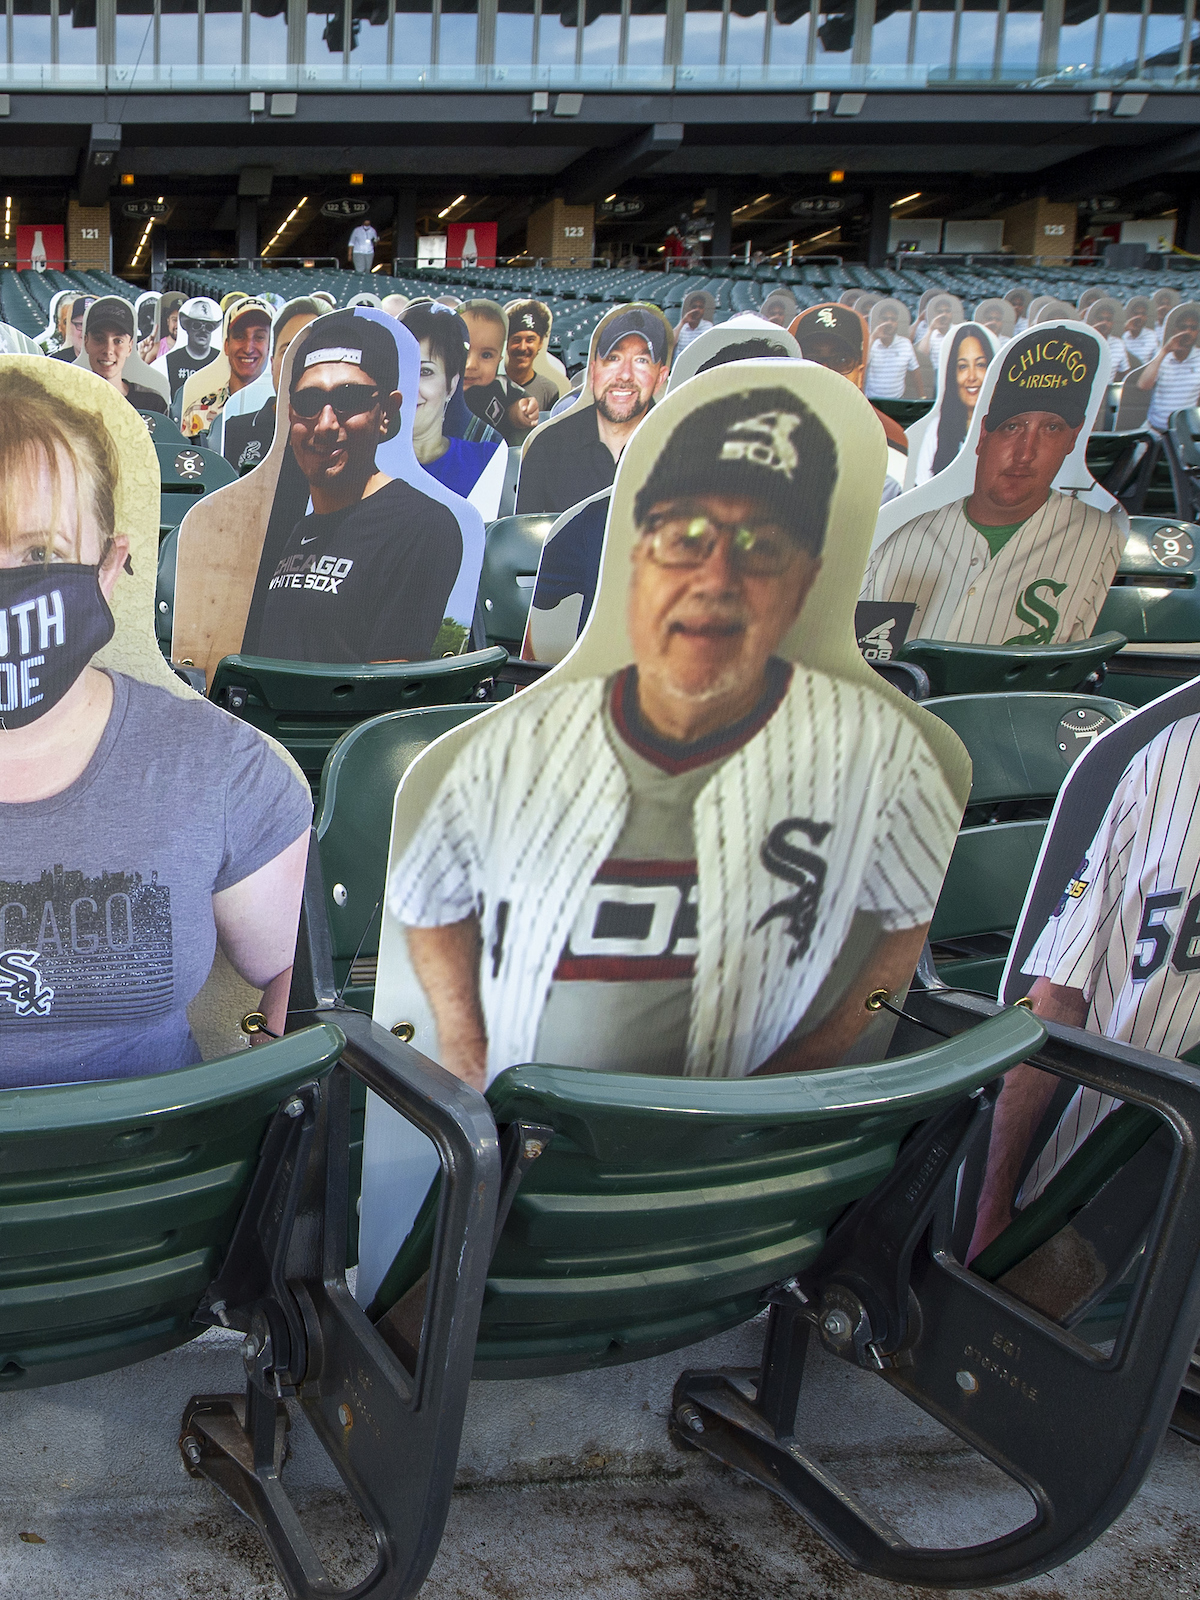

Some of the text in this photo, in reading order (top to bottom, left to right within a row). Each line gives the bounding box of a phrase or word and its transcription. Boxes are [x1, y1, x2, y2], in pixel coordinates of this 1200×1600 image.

[81, 228, 99, 239] 121
[564, 227, 584, 237] 123
[1044, 225, 1065, 235] 125
[1008, 340, 1087, 383] CHICAGO
[1026, 374, 1062, 389] IRISH
[183, 459, 196, 471] 6
[1163, 539, 1180, 556] 9
[274, 554, 354, 579] CHICAGO
[268, 573, 344, 595] WHITE SOX
